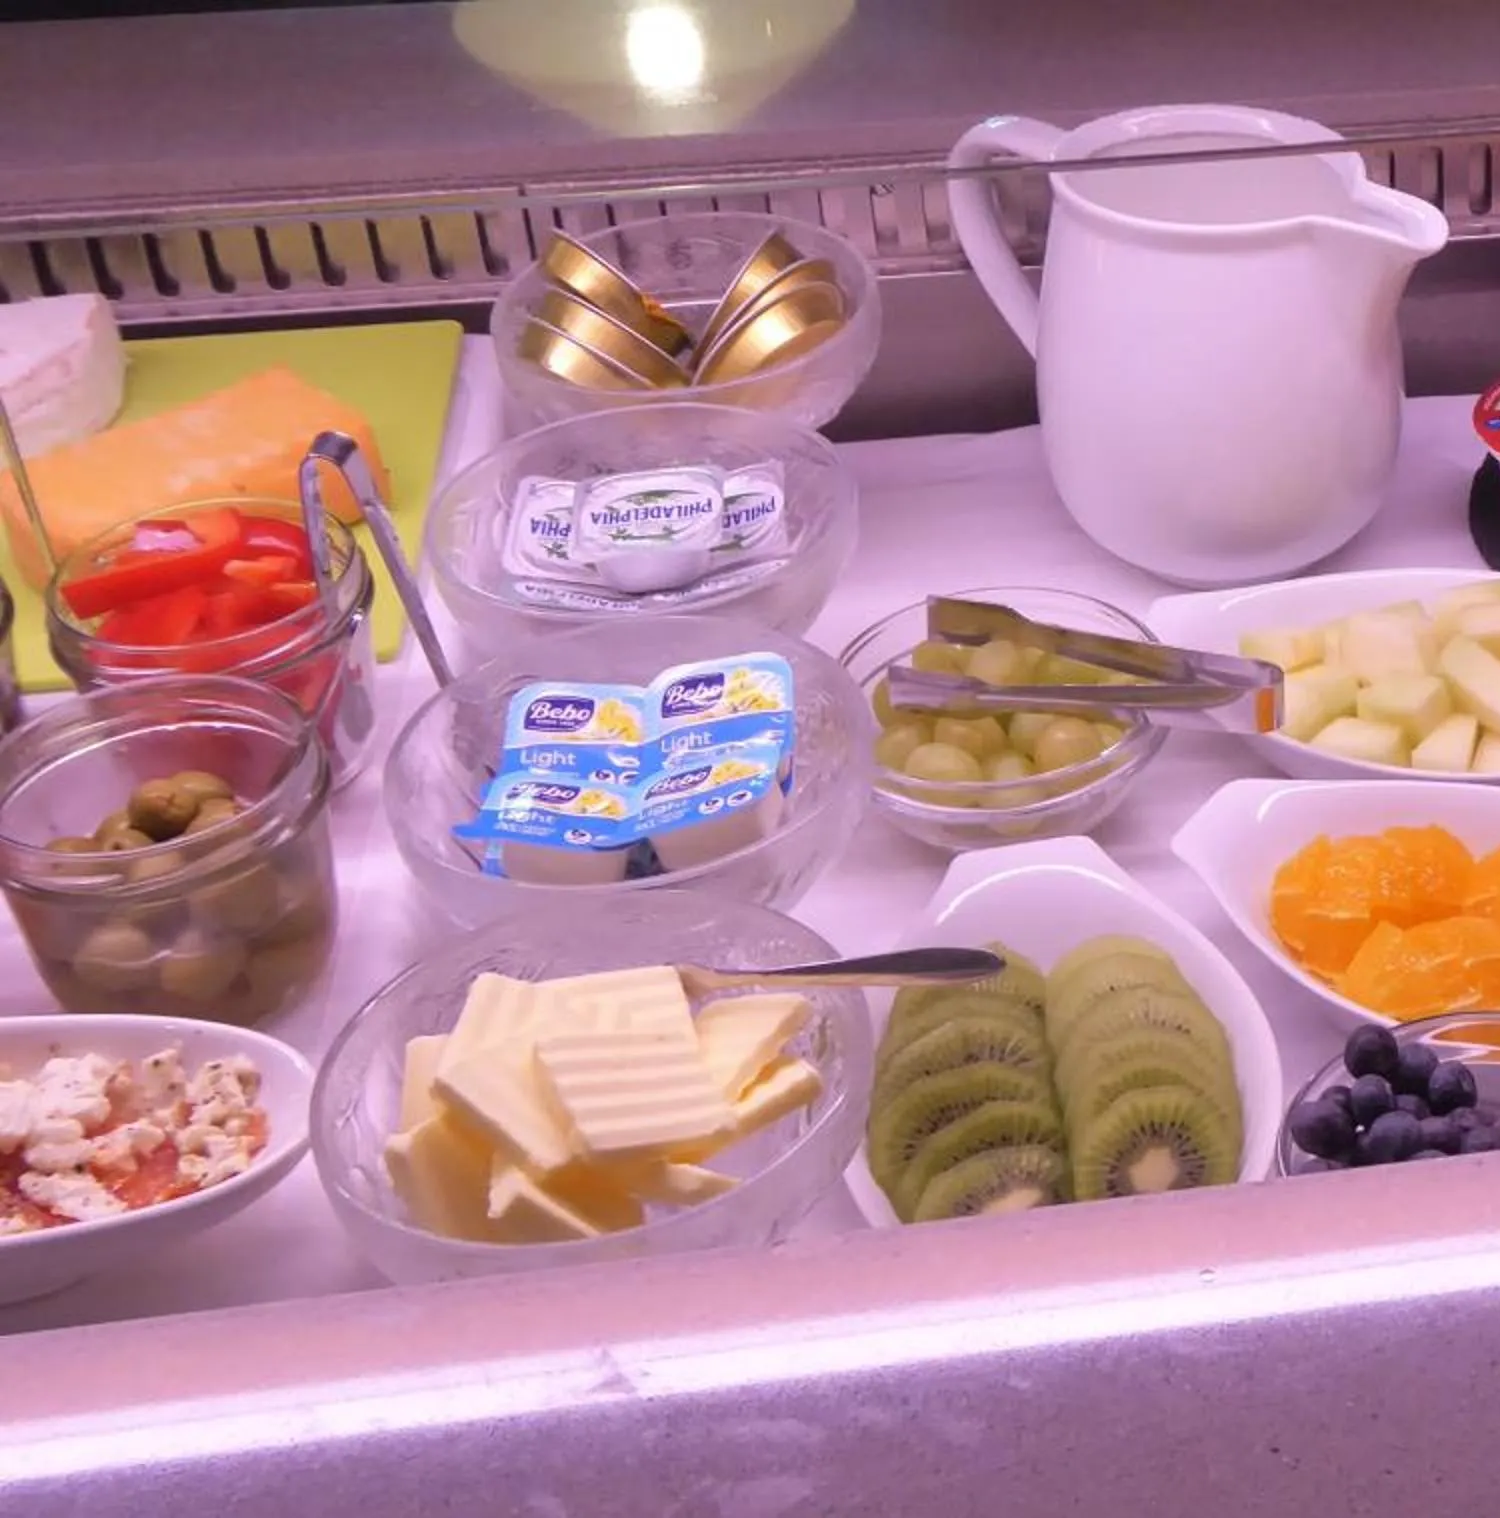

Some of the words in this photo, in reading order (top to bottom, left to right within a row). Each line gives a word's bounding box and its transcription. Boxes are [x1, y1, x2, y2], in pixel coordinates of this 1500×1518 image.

[590, 498, 714, 525] PHILADELPHIA
[667, 680, 724, 705] Bebo
[530, 703, 592, 723] Bebo
[661, 730, 713, 754] Light
[519, 751, 577, 769] Light
